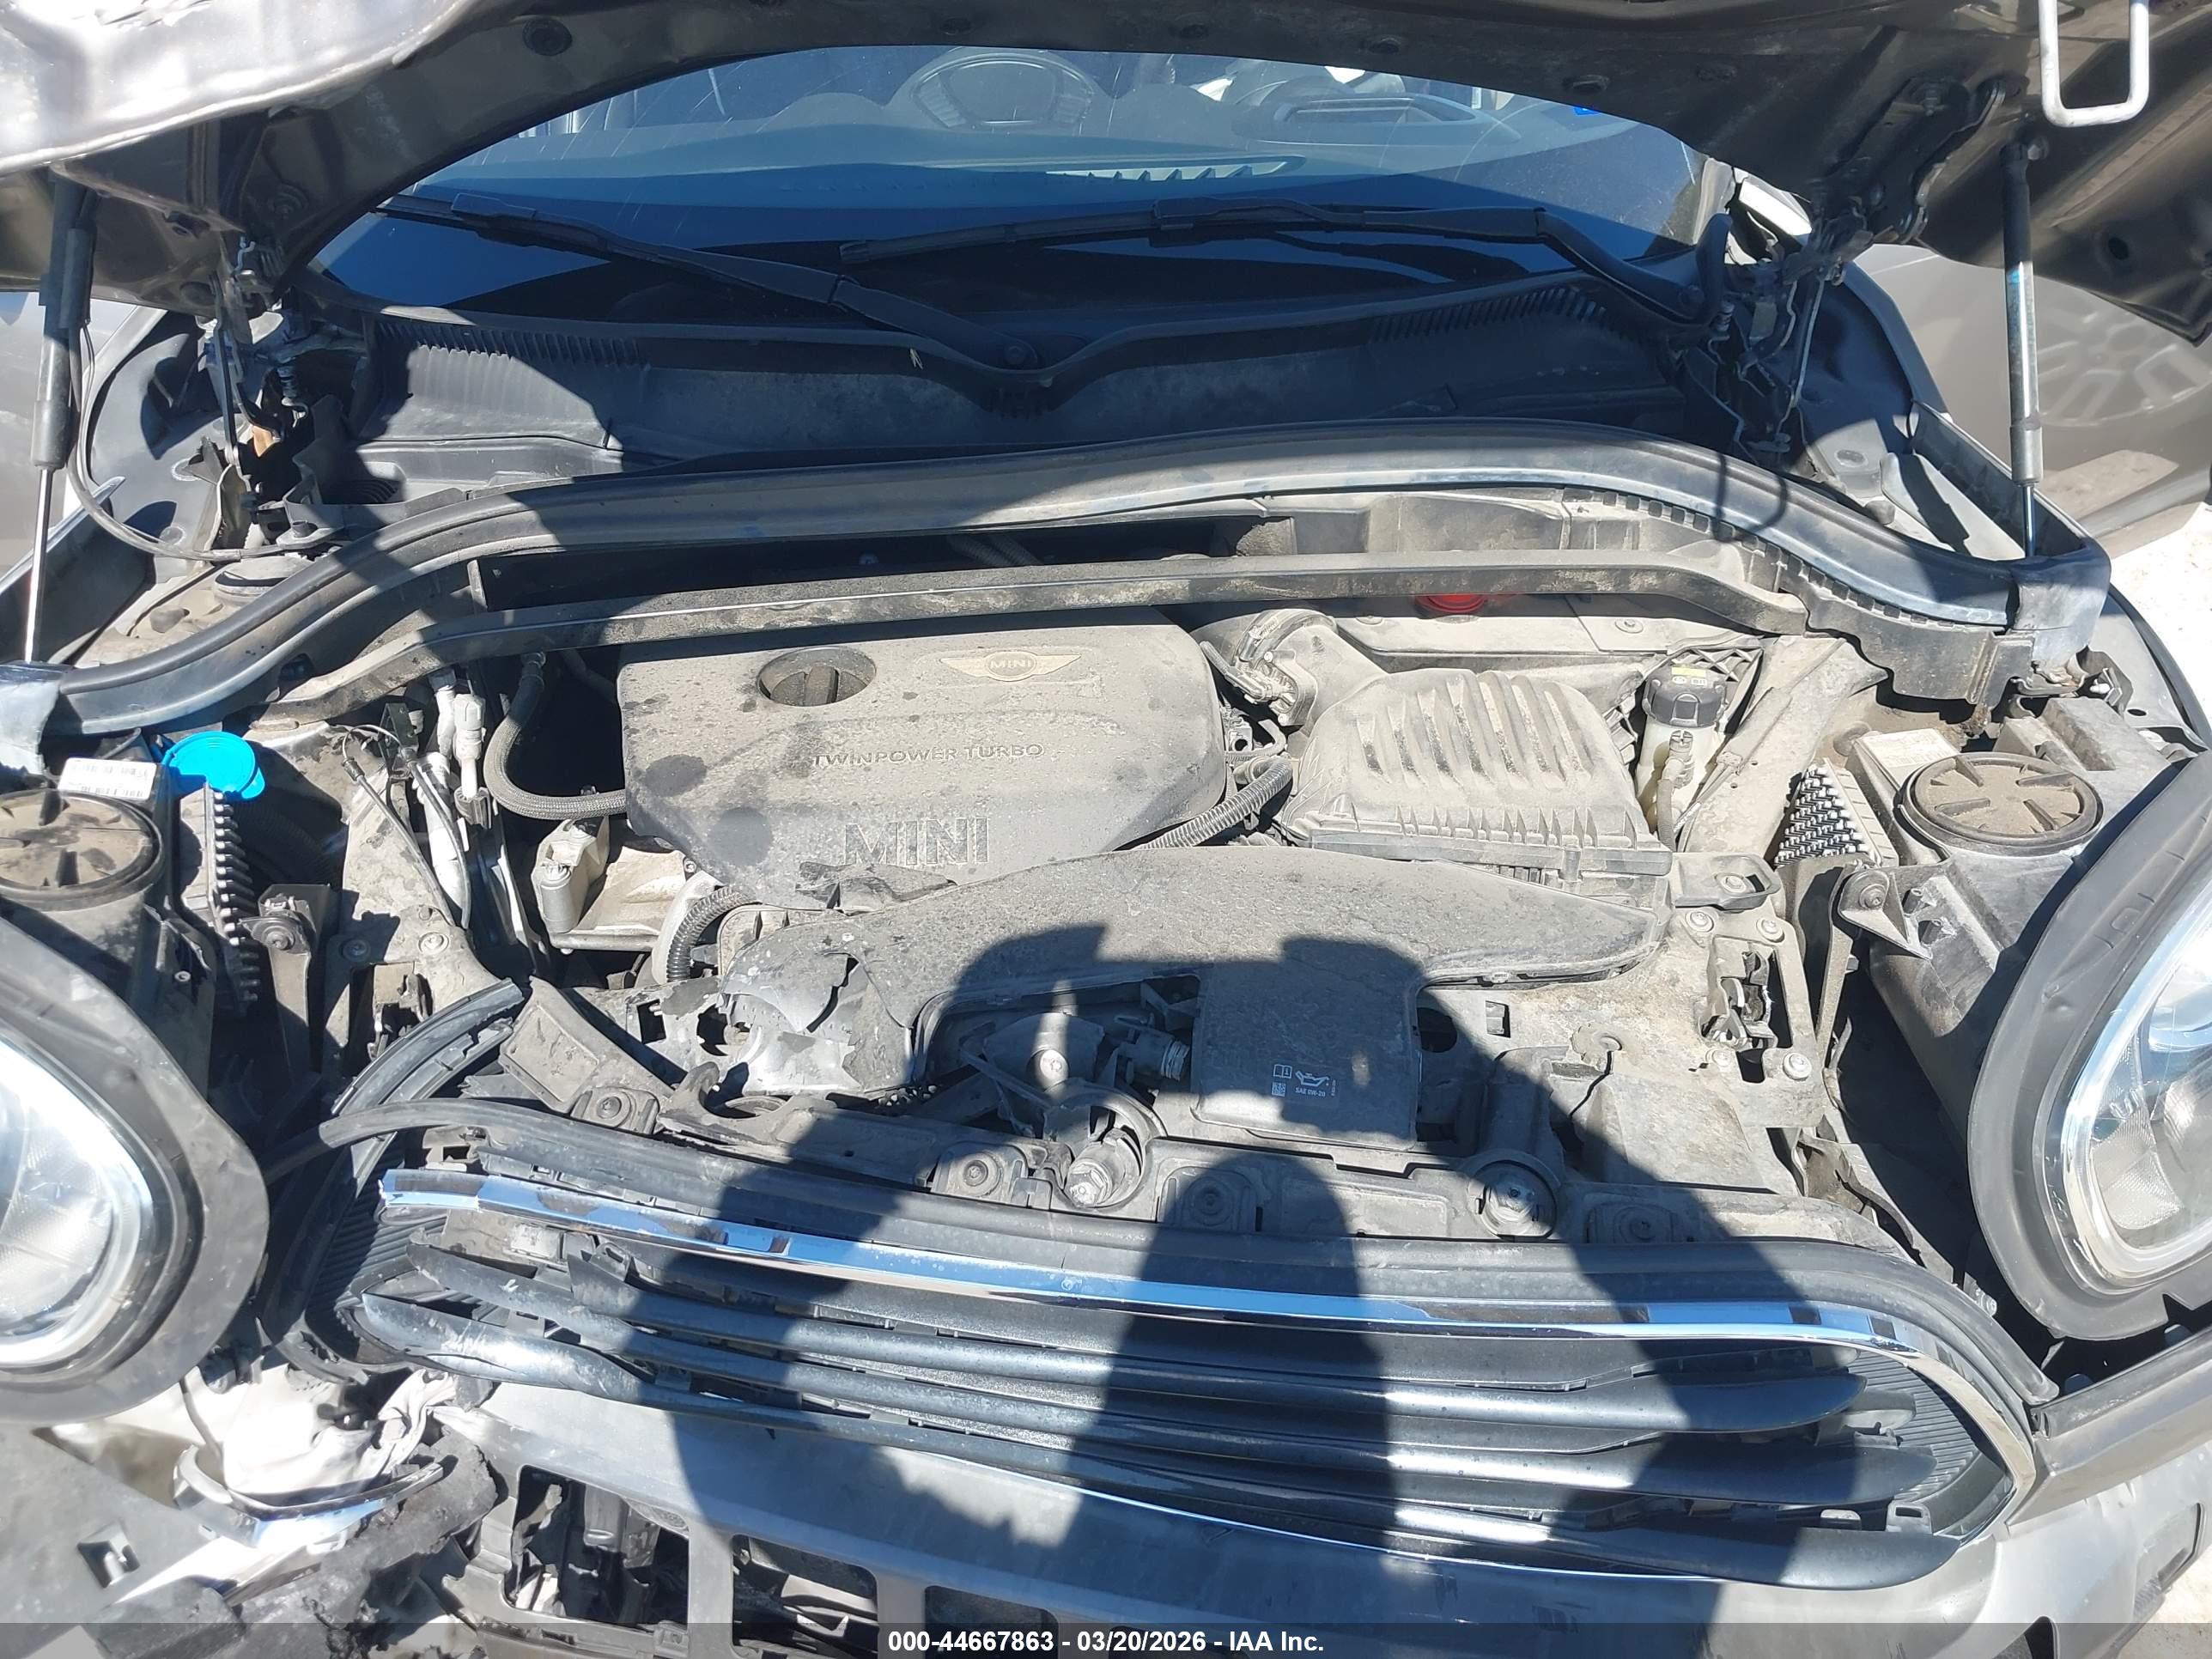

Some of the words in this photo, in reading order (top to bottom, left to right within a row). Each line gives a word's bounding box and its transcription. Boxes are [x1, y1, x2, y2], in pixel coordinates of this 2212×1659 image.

[990, 659, 1031, 669] MINI
[812, 746, 958, 767] TWINPOWER
[964, 744, 1045, 760] TURBO
[844, 817, 989, 866] MINI
